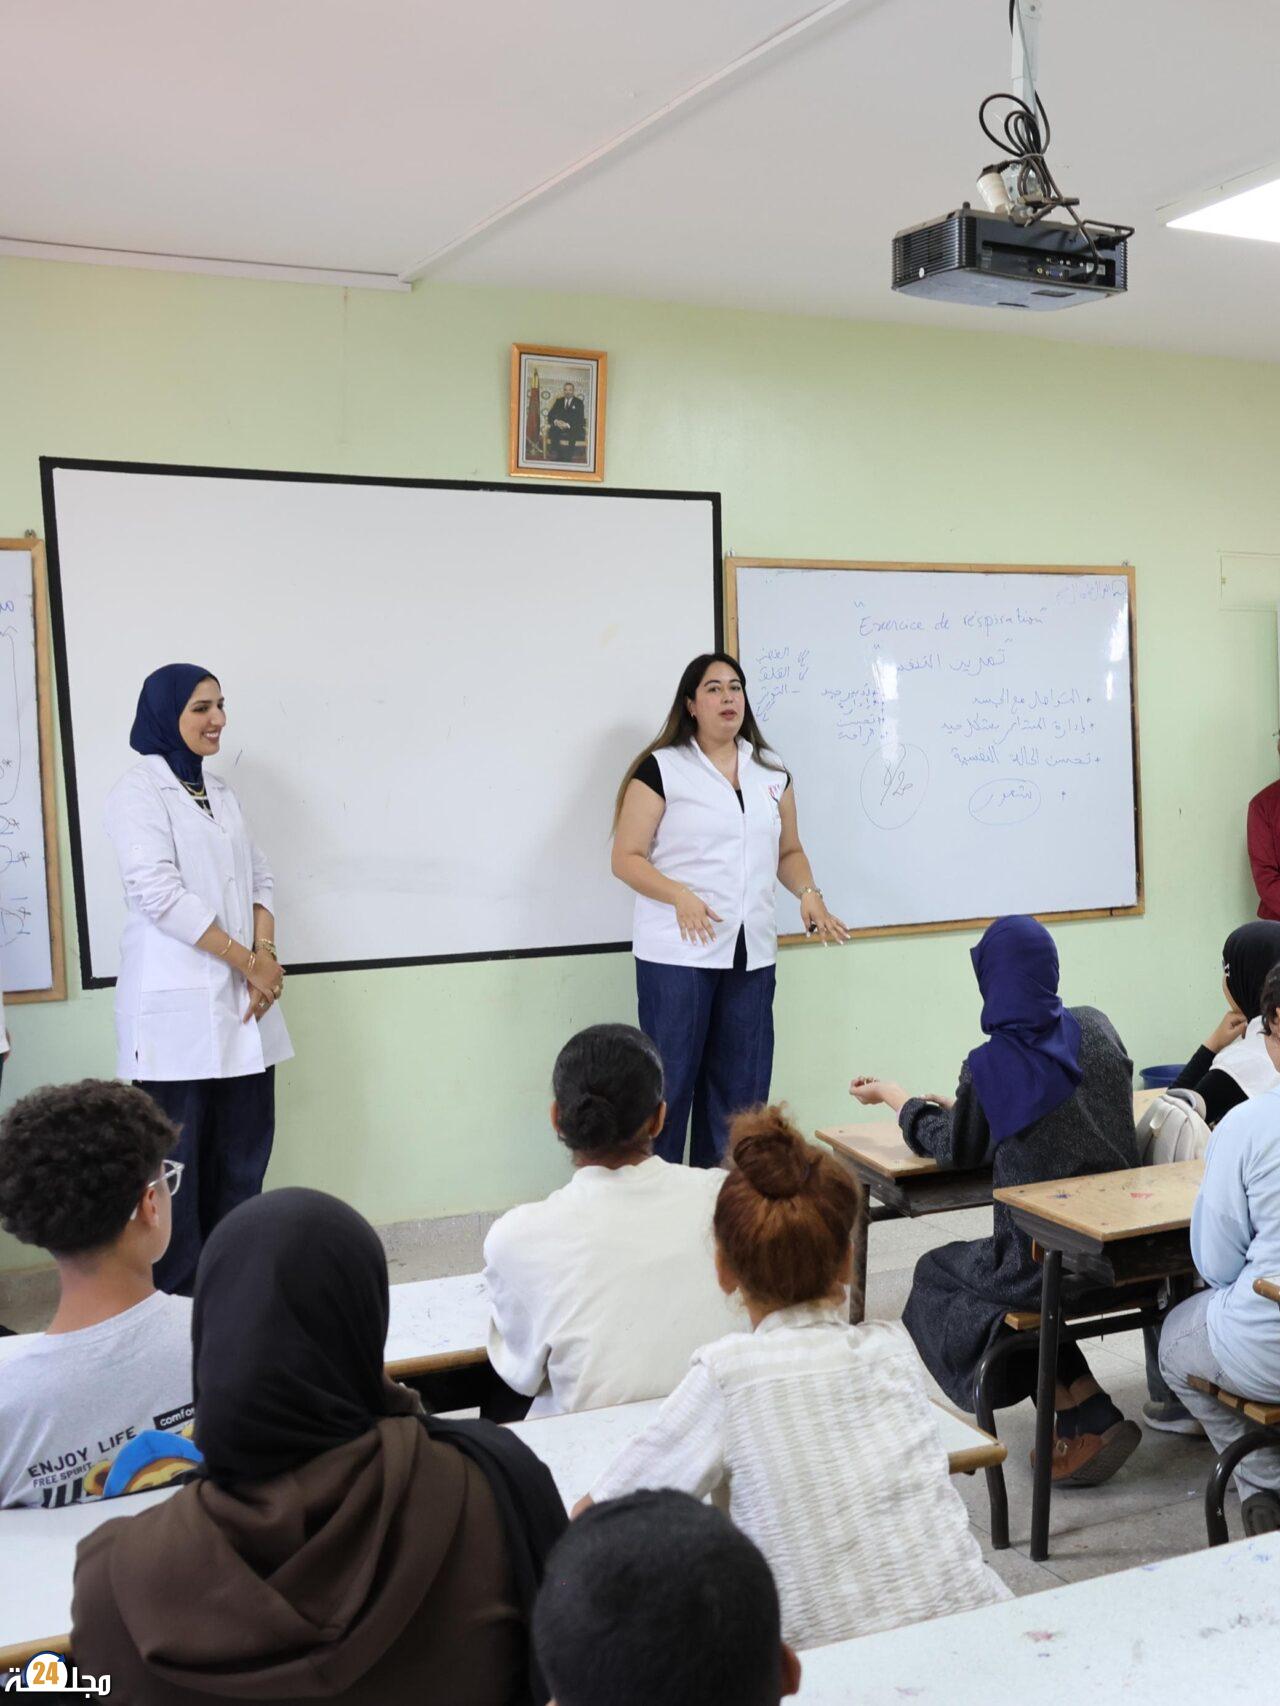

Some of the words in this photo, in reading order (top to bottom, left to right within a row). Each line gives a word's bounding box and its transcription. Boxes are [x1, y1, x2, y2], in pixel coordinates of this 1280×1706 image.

[934, 612, 949, 631] de
[28, 1447, 89, 1478] ENJOY
[98, 1426, 136, 1453] LIFE
[33, 1474, 58, 1488] FREE
[60, 1462, 93, 1480] SPIRIT
